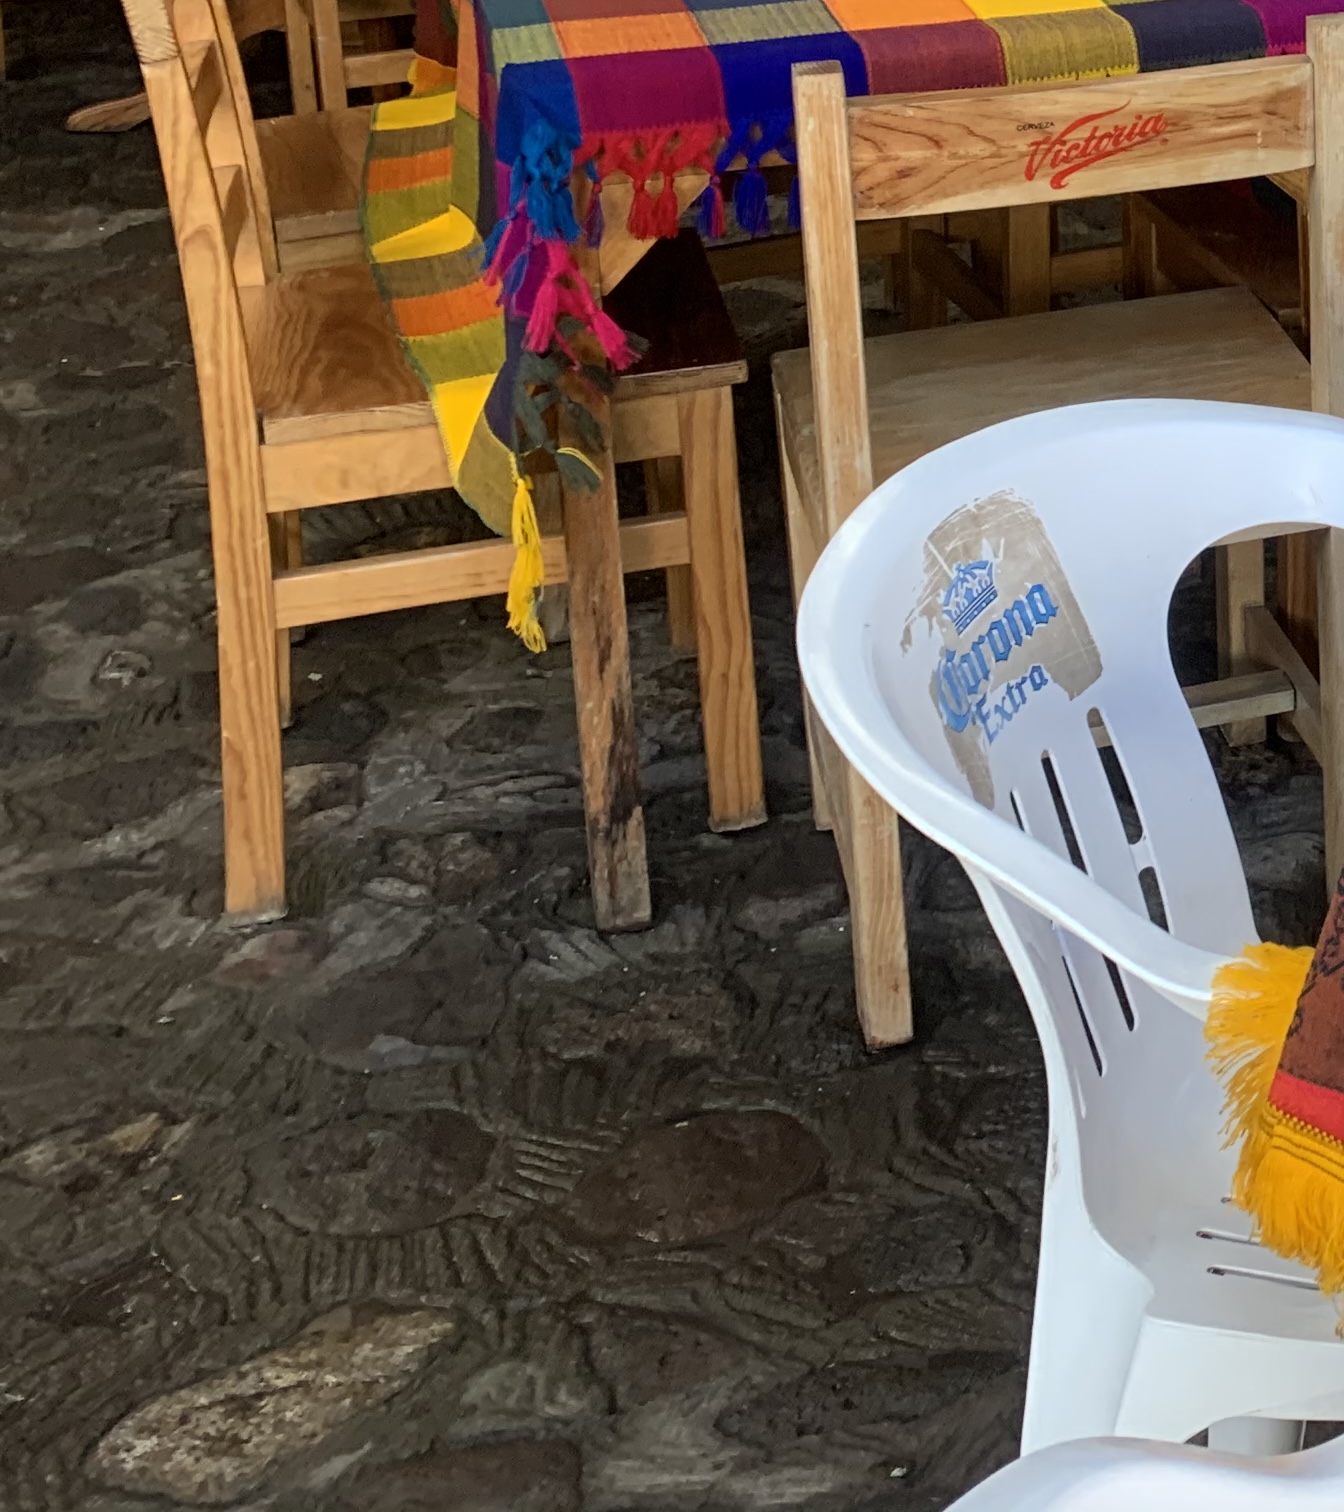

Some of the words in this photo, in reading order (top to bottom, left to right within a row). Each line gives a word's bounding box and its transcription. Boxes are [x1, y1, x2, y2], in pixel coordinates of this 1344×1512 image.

[1016, 121, 1055, 132] CERVEZA
[1024, 98, 1169, 189] Victoria
[934, 582, 1059, 734] Corona
[973, 663, 1049, 745] Extra
